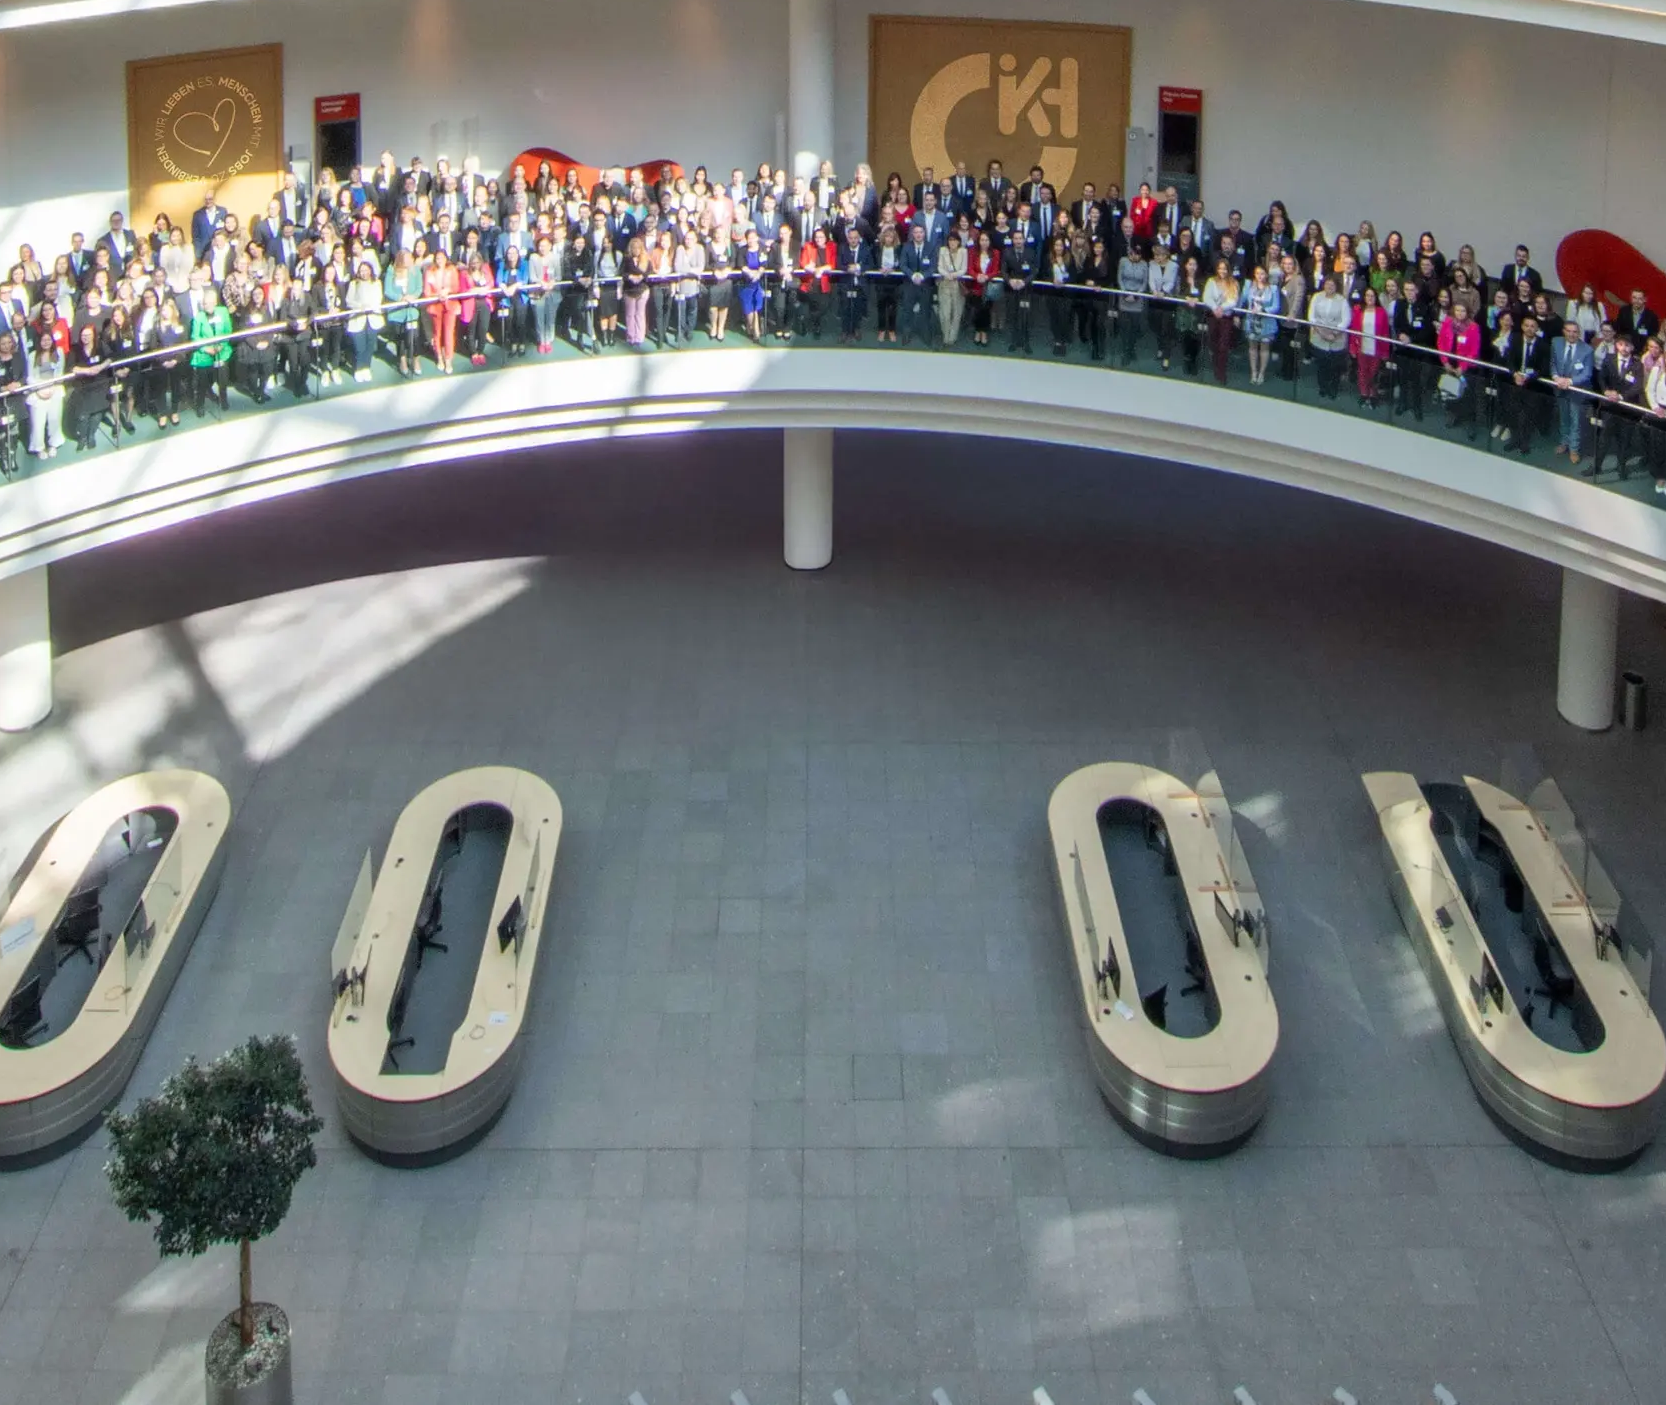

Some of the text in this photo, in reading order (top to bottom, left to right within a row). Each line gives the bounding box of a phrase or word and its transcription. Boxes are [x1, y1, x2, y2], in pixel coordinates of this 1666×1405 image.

[161, 81, 196, 115] LIEBEN
[218, 76, 263, 124] MENSCHEN
[154, 117, 167, 142] WIR
[249, 126, 263, 149] MIT
[228, 148, 254, 176] JOBS
